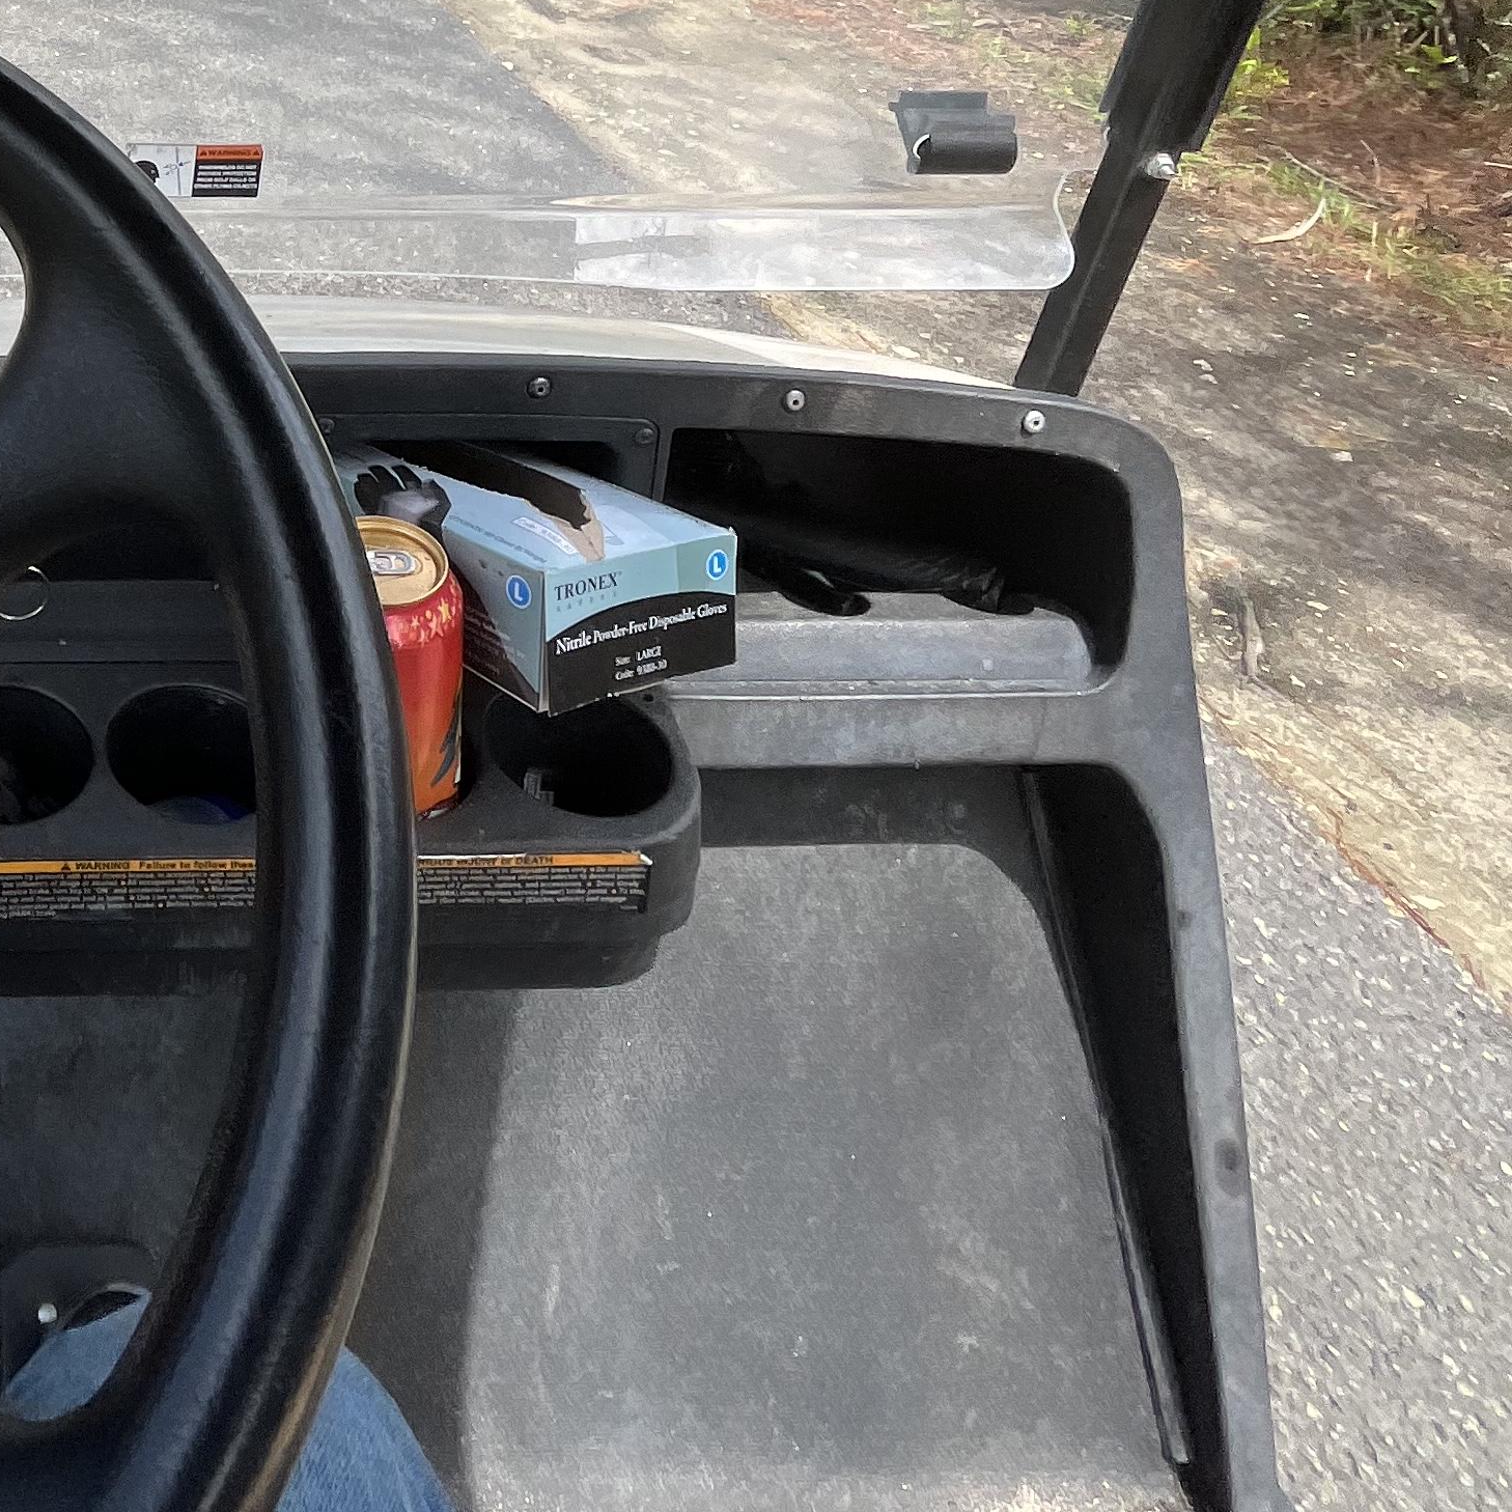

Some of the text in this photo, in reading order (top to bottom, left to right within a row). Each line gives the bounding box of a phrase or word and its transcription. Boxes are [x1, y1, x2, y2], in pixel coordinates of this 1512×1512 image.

[208, 149, 251, 157] WARNING
[554, 571, 619, 601] TRONEX
[554, 603, 728, 655] Nitrile Powder-Free Disposable Gloves
[636, 645, 662, 661] LARGE
[75, 862, 130, 870] WARNING
[139, 861, 176, 870] Failure
[516, 856, 553, 865] DEATH
